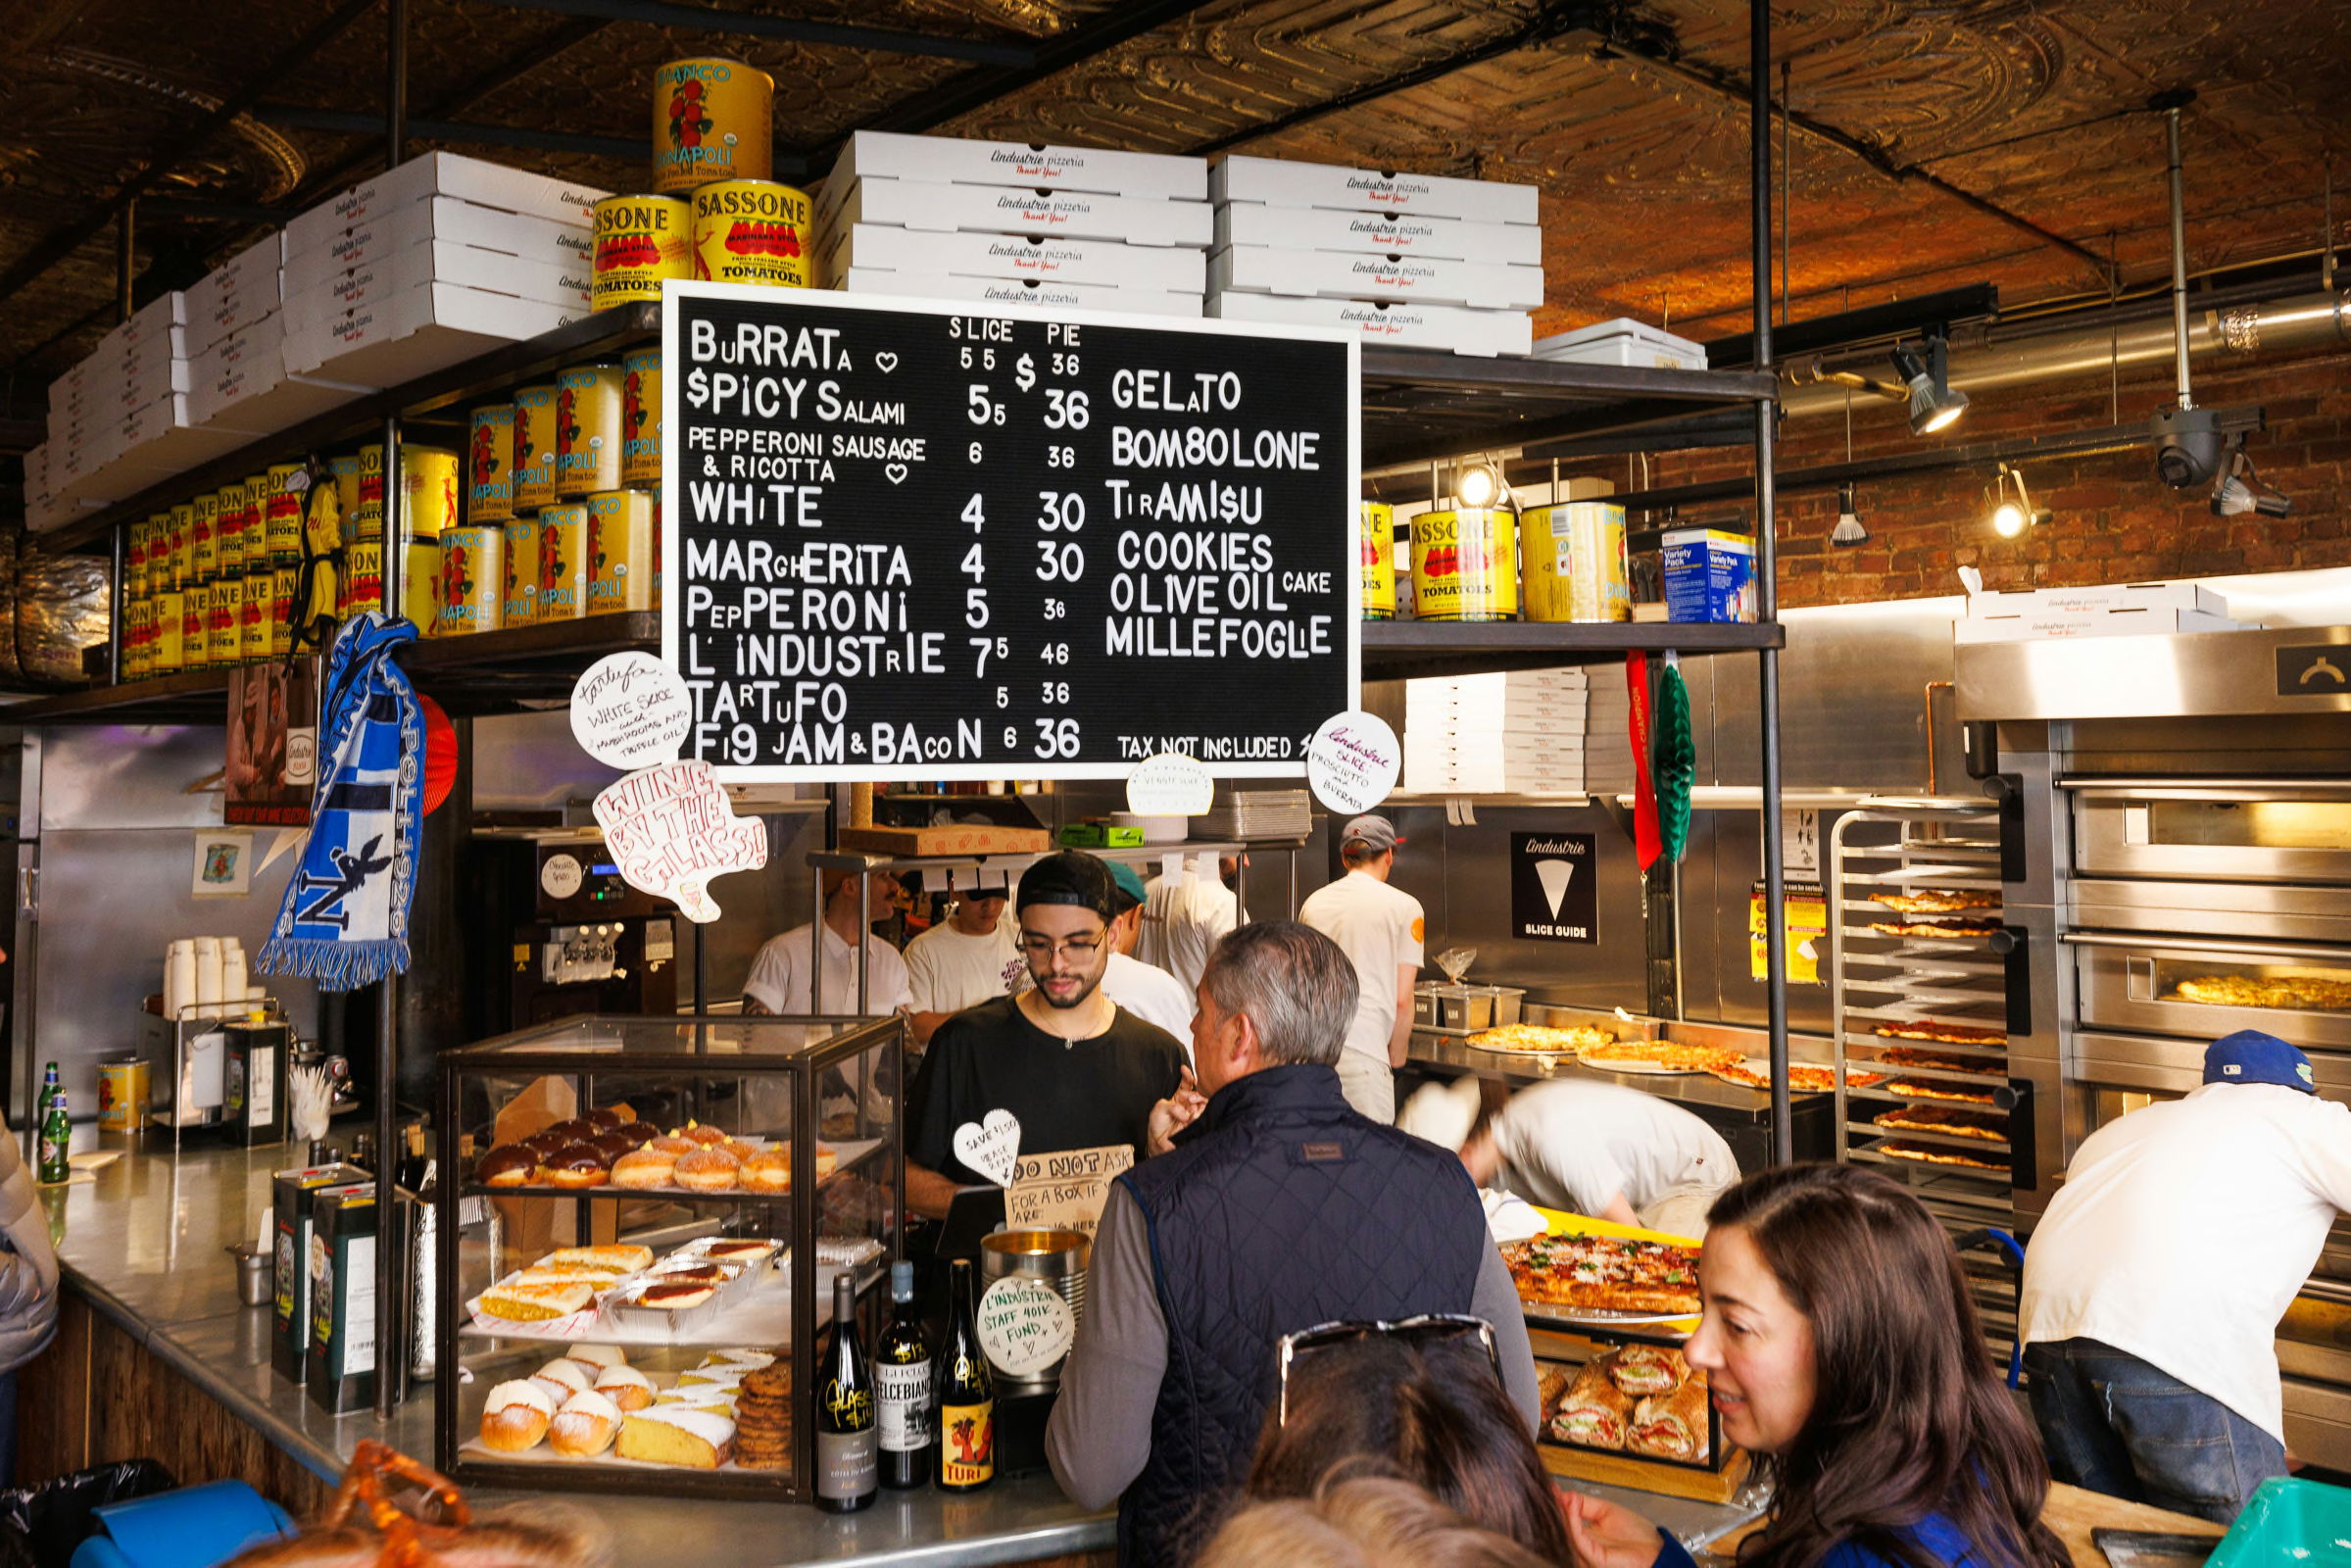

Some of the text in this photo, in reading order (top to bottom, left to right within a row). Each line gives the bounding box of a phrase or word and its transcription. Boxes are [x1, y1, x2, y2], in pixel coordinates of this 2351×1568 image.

[1047, 154, 1084, 168] pizzeria
[1396, 180, 1429, 194] pizzeria
[698, 191, 805, 225] SASSONE
[1053, 200, 1090, 214] pizzeria
[595, 206, 668, 233] SSONE
[1399, 223, 1432, 236] pizzeria
[1045, 247, 1082, 261] pizzeria
[721, 267, 803, 285] TOMATOES
[1401, 265, 1435, 278] pizzeria
[594, 280, 662, 296] TOMATOES
[1041, 291, 1078, 305] pizzeria
[1390, 313, 1423, 325] pizzeria
[950, 317, 1080, 347] SLICE PIE
[1053, 353, 1080, 376] 36
[1112, 368, 1241, 413] GELATO
[815, 380, 905, 425] SALAMI
[1044, 389, 1089, 429] 36
[624, 437, 661, 456] APOLI
[689, 426, 1075, 468] PEPPERONI SAUSAGE 6 36
[557, 452, 596, 470] APOLI
[703, 455, 835, 482] & RICOTTA
[514, 468, 549, 484] APOLI
[961, 493, 985, 534] 4
[1038, 492, 1086, 532] 30
[444, 532, 488, 549] ANCO
[1412, 519, 1494, 545] ASSONE
[1117, 530, 1273, 572] COOKIES
[1664, 549, 1691, 559] Variety
[961, 543, 985, 583] 4
[1036, 541, 1084, 582] 30
[1664, 558, 1684, 566] Pack
[540, 588, 580, 606] APOLI
[1228, 571, 1288, 612] OIL
[1283, 571, 1331, 594] CAKE
[440, 604, 490, 621] NAPOLI
[965, 588, 989, 629] 5
[1044, 598, 1065, 619] 36
[1041, 643, 1069, 664] 46
[686, 680, 1069, 723] TARTUFO 5 36
[588, 702, 633, 729] WHITE
[772, 722, 844, 764] JAM
[851, 732, 866, 754] &
[872, 717, 981, 764] BACON
[1004, 726, 1017, 748] 6
[1035, 718, 1080, 760] 36
[1117, 736, 1292, 760] TAX NOT INCLUDED
[598, 763, 715, 824] WINE
[610, 792, 726, 859] BY THE
[1525, 923, 1588, 939] SLICE GUIDE
[966, 1130, 992, 1151] SAVE
[1050, 1152, 1100, 1176] NOT
[1103, 1152, 1130, 1172] ASK
[1011, 1194, 1039, 1213] FOR
[1041, 1191, 1051, 1203] A
[1054, 1186, 1084, 1203] BOX
[1088, 1183, 1098, 1196] IF
[984, 1309, 1017, 1331] STAFF
[1006, 1322, 1041, 1343] FUND
[947, 1464, 981, 1482] TURI
